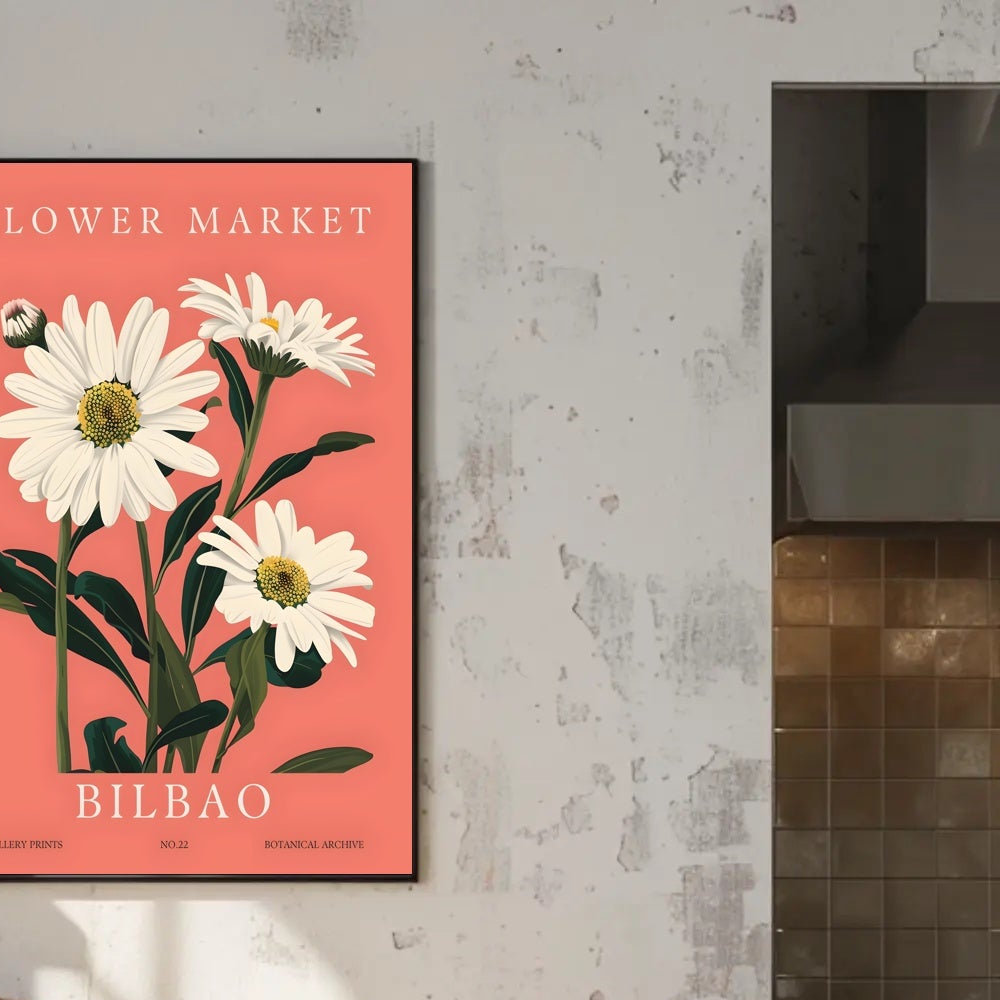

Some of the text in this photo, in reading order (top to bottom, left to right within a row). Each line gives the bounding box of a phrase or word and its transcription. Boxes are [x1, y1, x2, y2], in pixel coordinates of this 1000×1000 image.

[188, 205, 373, 236] MARKET
[75, 783, 273, 820] BILBAO
[29, 839, 64, 850] PRINTS
[160, 839, 189, 850] NO.22
[264, 839, 365, 850] BOTANICAL ARCHIVE
